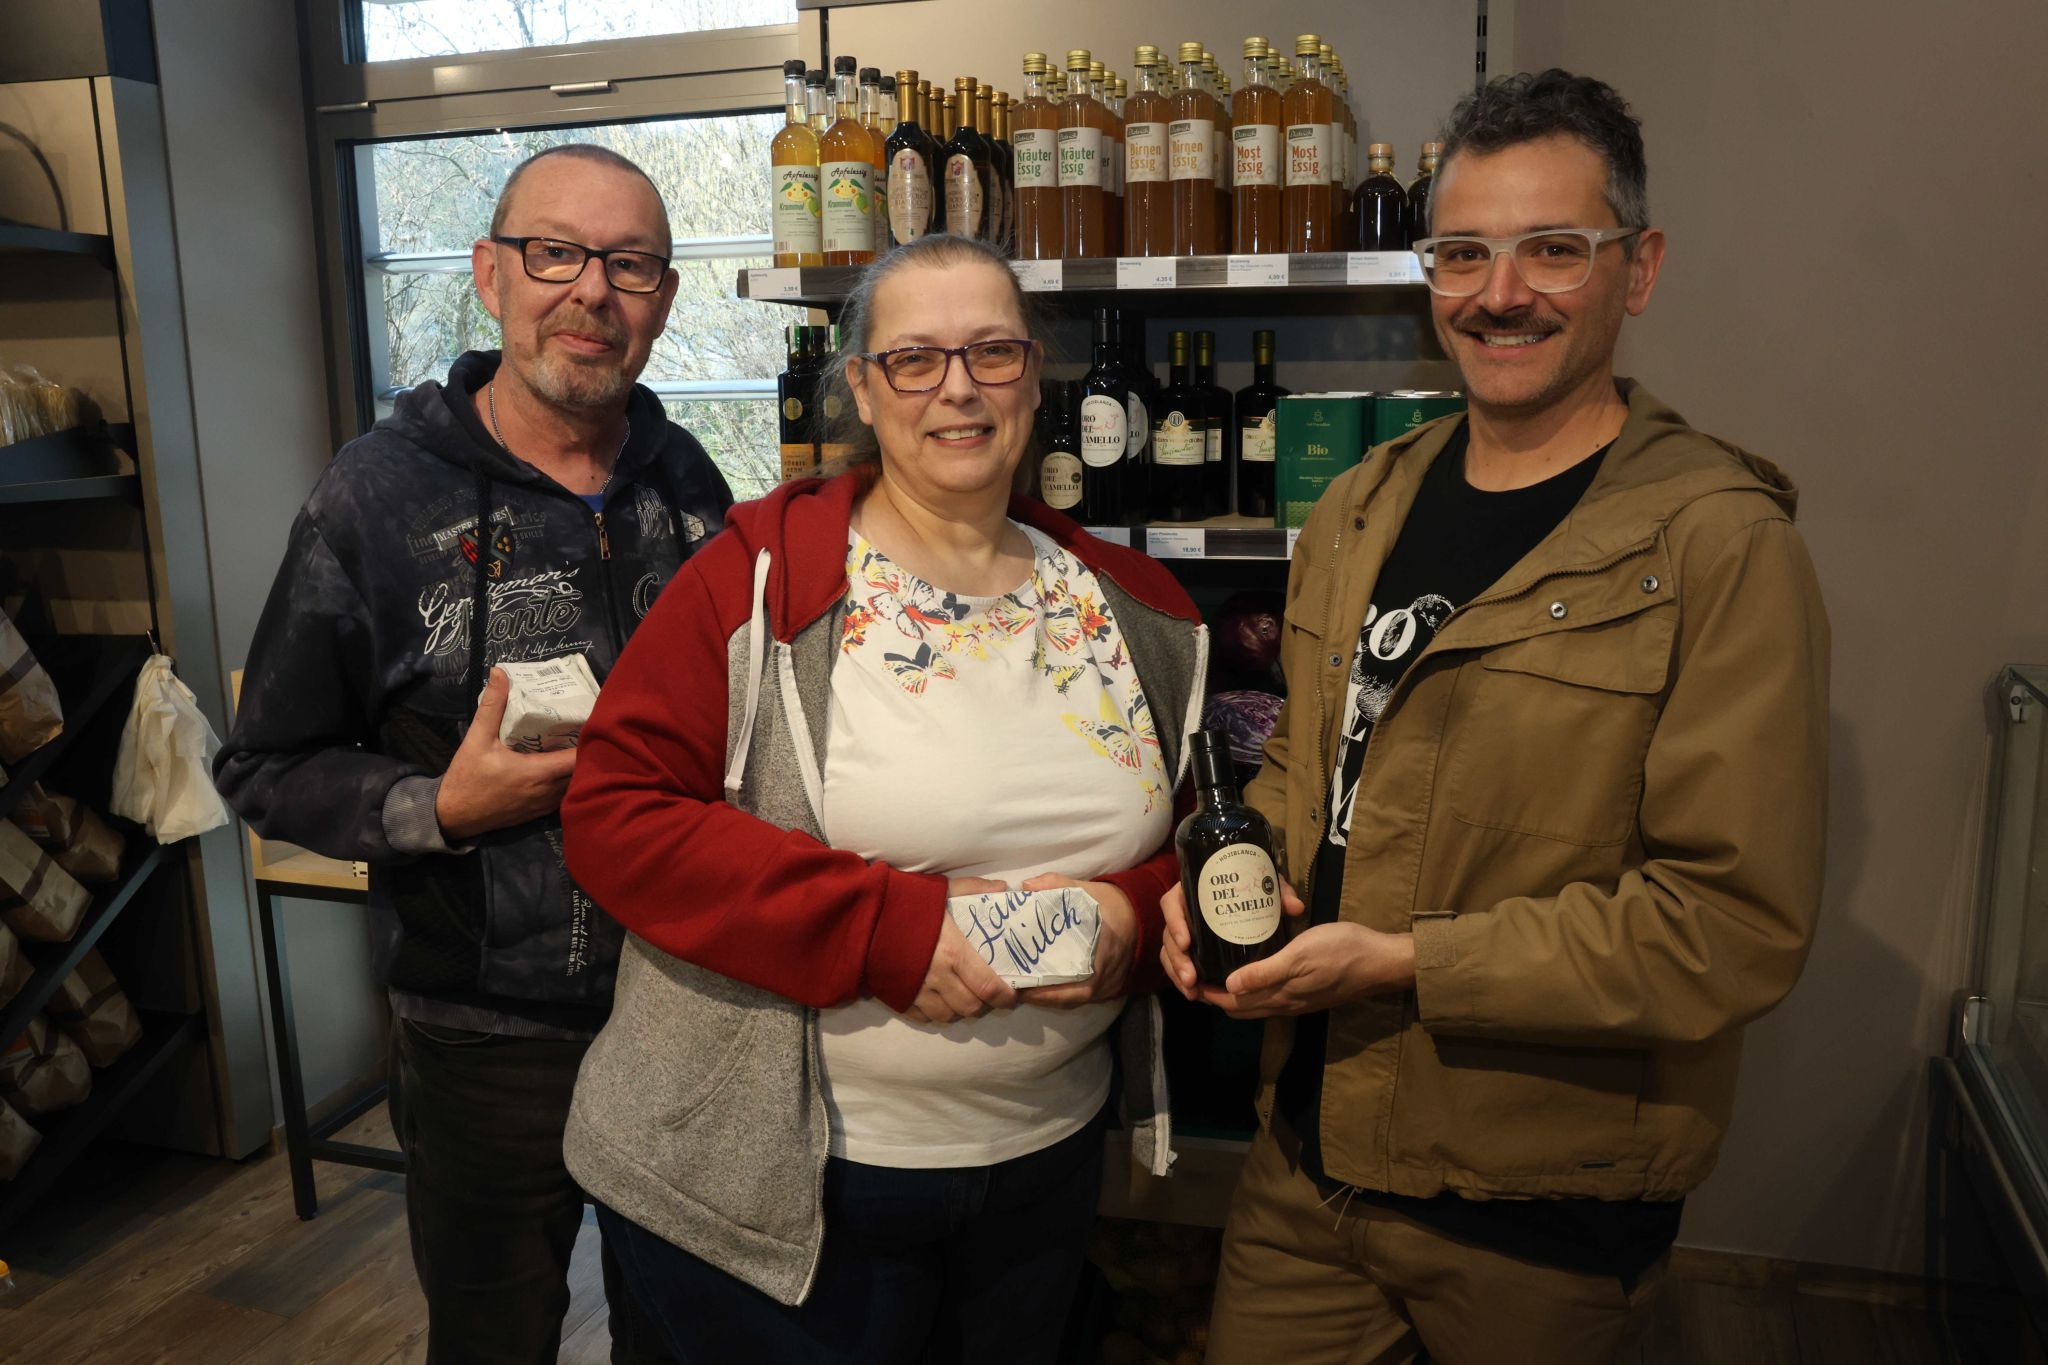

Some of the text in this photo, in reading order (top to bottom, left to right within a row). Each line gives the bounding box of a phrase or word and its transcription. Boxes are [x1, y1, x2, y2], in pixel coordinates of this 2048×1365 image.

[1061, 146, 1095, 160] Kräuter
[1130, 142, 1161, 156] Birnen
[1172, 140, 1203, 154] Birnen
[1237, 145, 1261, 159] Most
[1292, 145, 1318, 158] Most
[1017, 148, 1052, 162] Kräuter
[1172, 153, 1197, 170] Essig
[1018, 161, 1041, 177] Essig
[1061, 160, 1084, 176] Essig
[1130, 156, 1155, 171] Essig
[1237, 159, 1263, 175] Essig
[1292, 158, 1319, 175] Essig
[831, 167, 867, 178] Apfelessig
[1307, 444, 1329, 455] Bio
[438, 521, 475, 541] MASTER
[1210, 872, 1240, 886] ORO
[1212, 887, 1240, 901] DEL
[1214, 897, 1274, 916] CAMELLO
[1004, 888, 1082, 975] Milch
